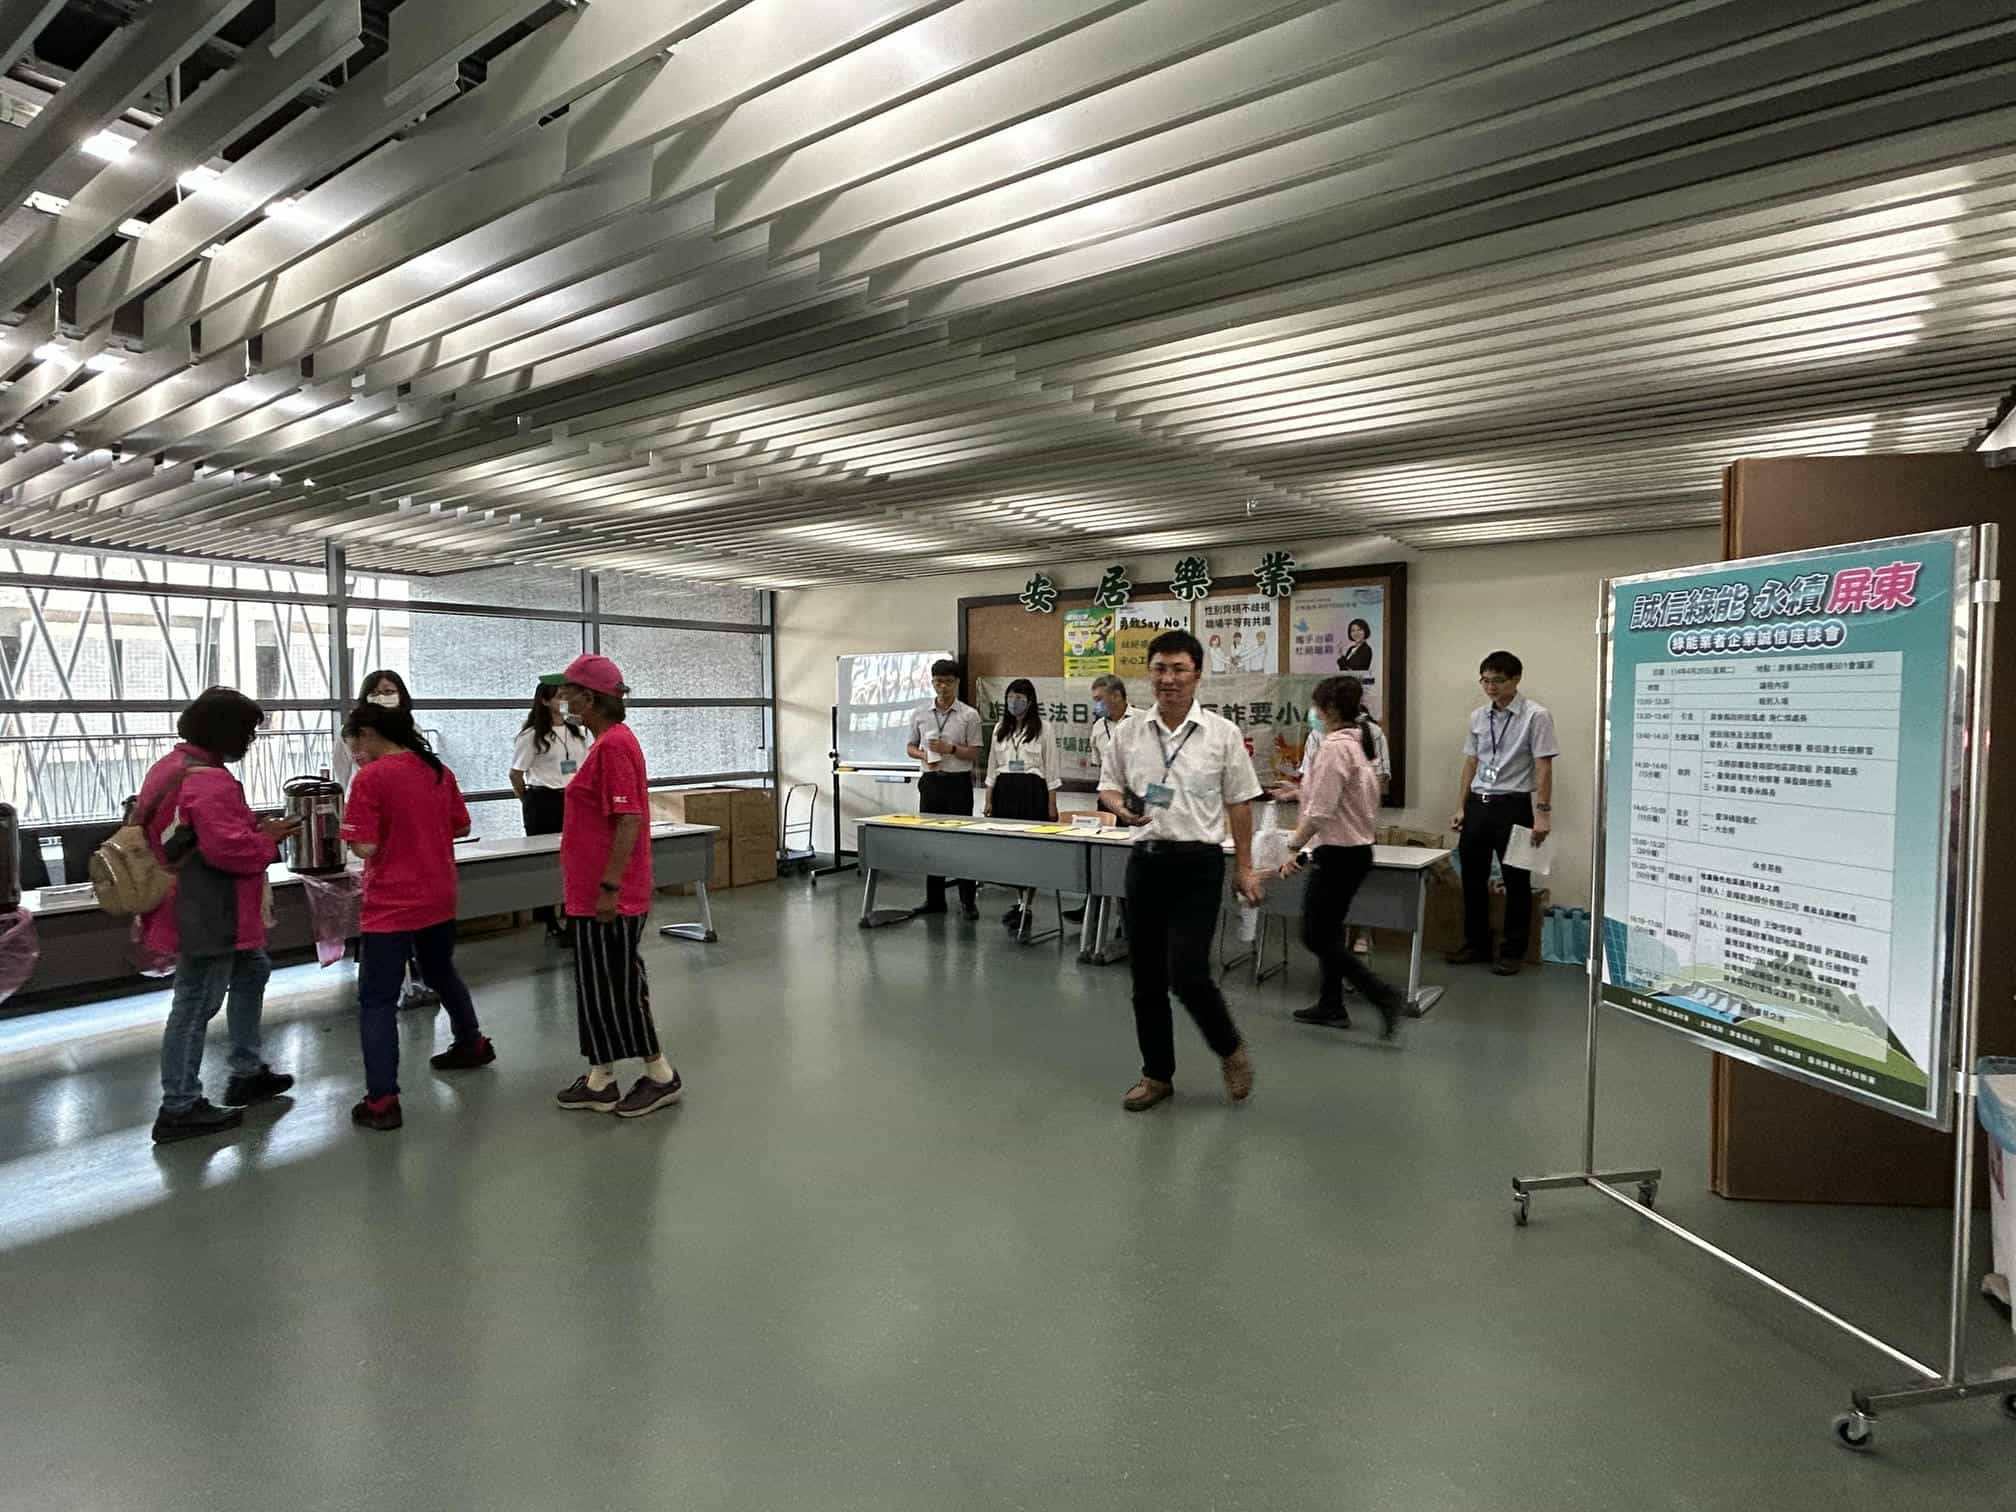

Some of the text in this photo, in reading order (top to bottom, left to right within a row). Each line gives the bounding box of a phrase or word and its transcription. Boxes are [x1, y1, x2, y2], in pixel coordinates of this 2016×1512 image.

[1019, 551, 1297, 613] 安居樂業
[1630, 560, 1922, 631] 誠信綠能 永續 屏東
